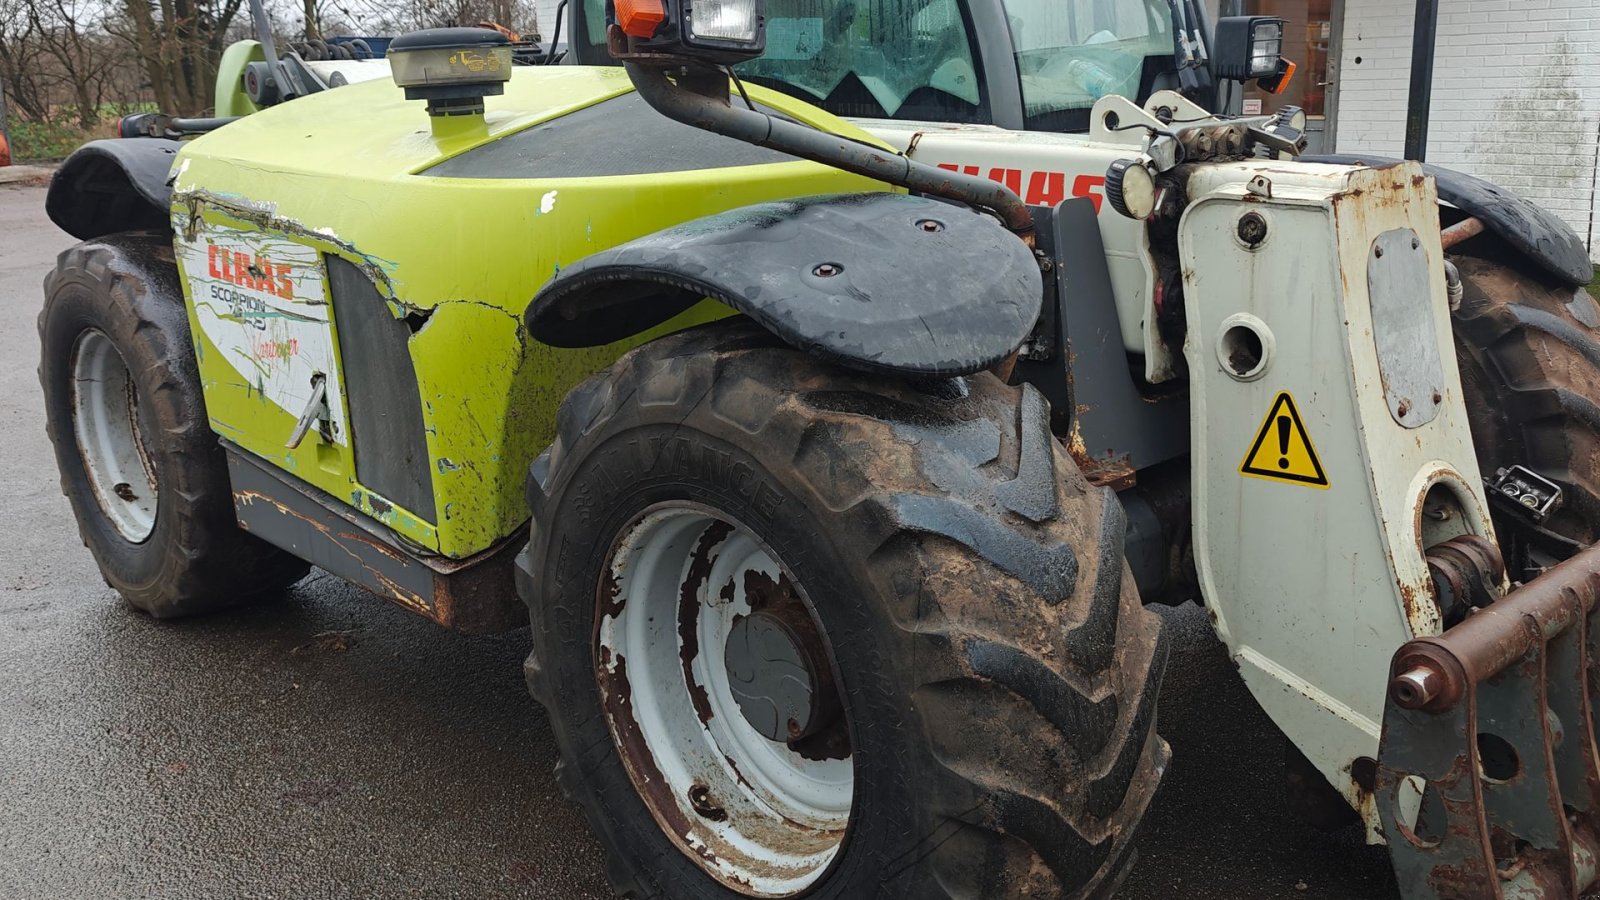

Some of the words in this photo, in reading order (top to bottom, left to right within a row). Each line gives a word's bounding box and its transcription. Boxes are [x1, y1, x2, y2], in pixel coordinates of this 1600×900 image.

[936, 163, 1106, 216] AAS
[208, 244, 293, 300] CLAAS
[211, 285, 266, 312] SCORPION
